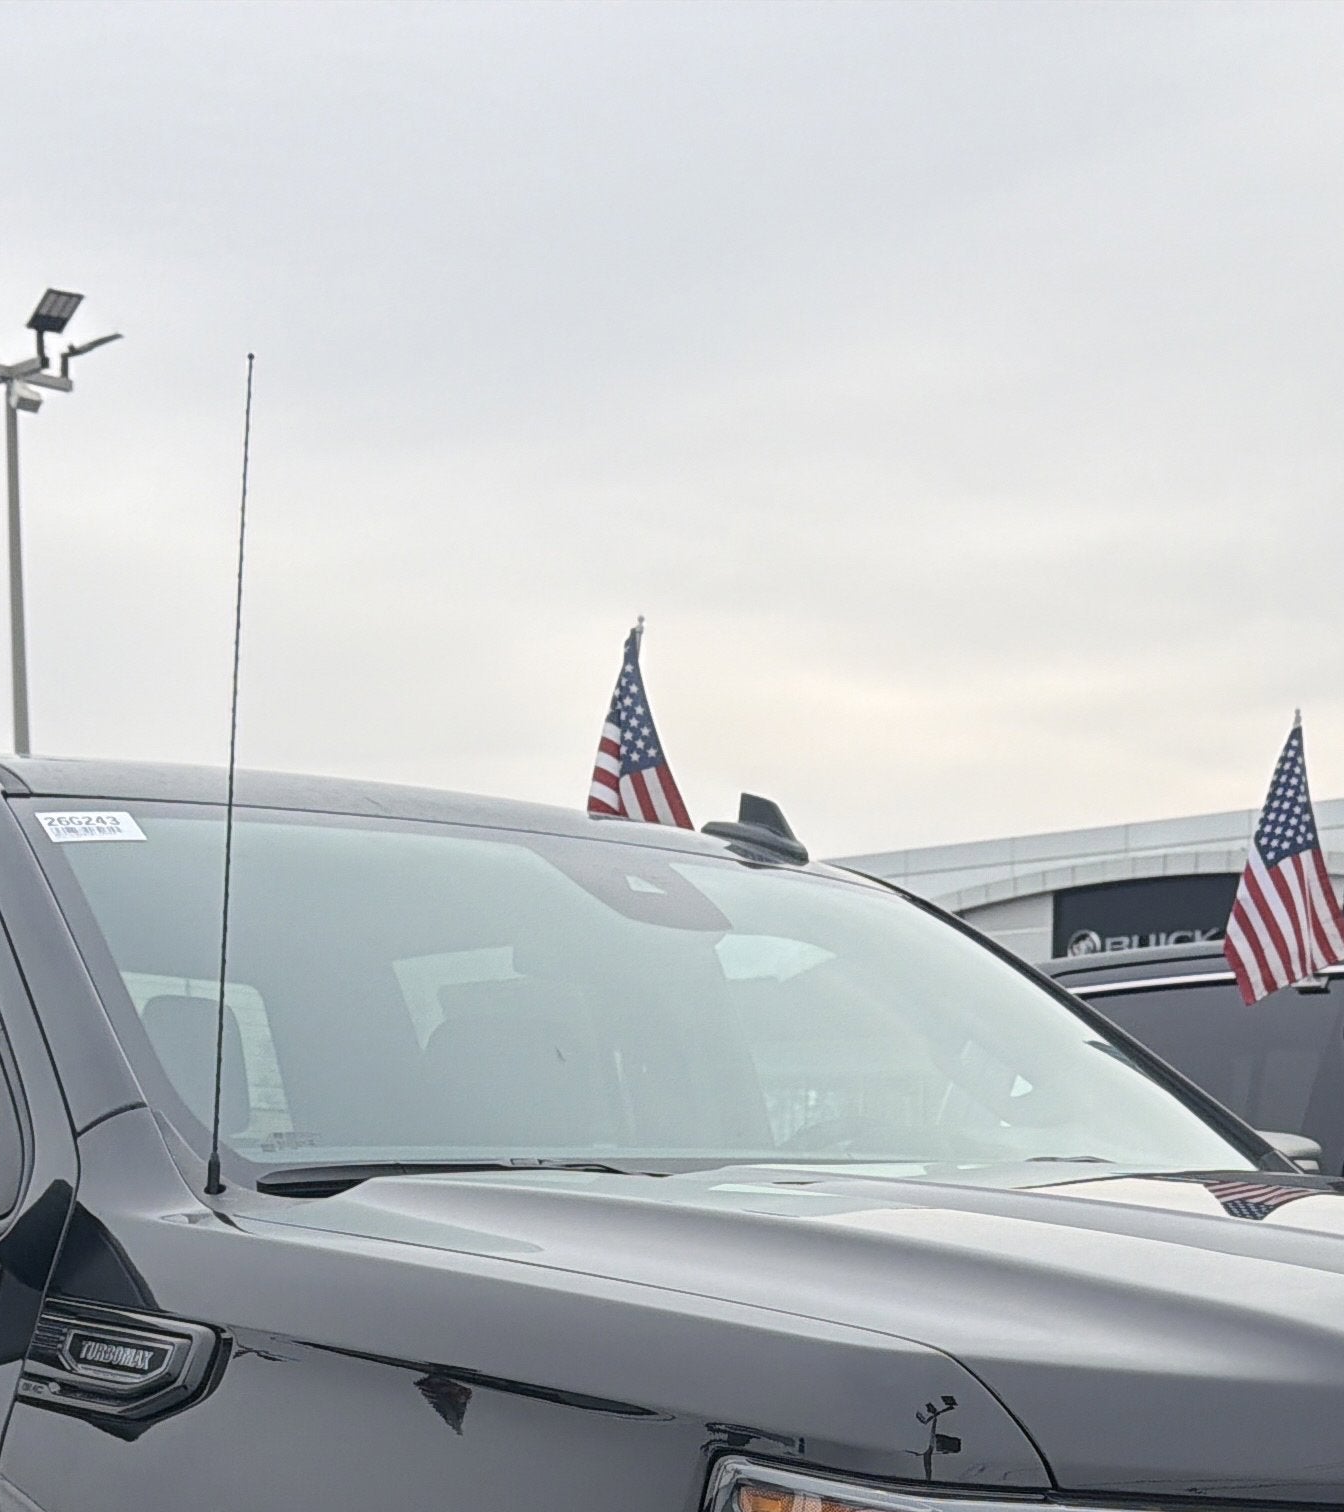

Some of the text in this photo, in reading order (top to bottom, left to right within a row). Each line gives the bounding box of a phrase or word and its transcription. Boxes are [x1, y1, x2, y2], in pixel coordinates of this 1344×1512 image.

[43, 815, 121, 827] 26G243
[1104, 927, 1220, 953] BUICK
[79, 1340, 155, 1371] TURBOMAX
